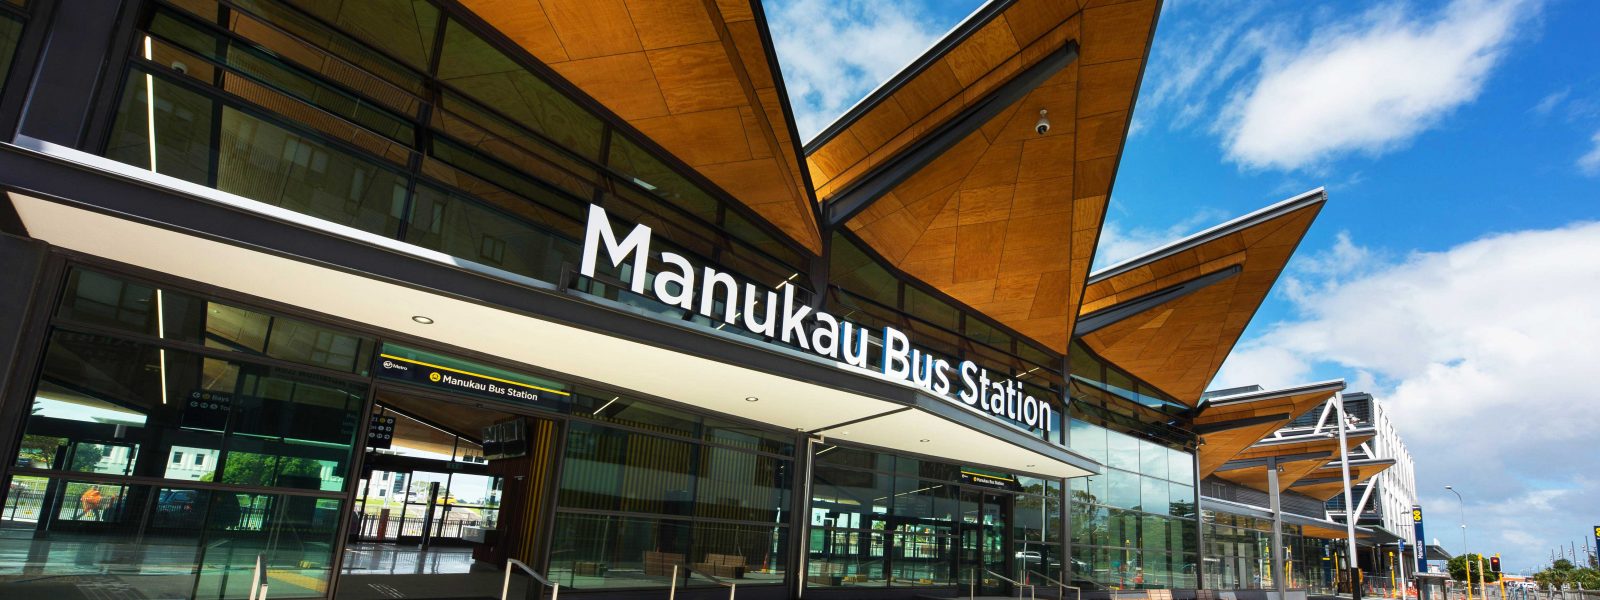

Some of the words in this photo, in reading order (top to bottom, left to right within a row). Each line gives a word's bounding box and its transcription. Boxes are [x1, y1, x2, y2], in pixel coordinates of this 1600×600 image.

[580, 203, 868, 369] Manukau
[883, 326, 950, 397] Bus
[958, 361, 1052, 432] Station
[393, 363, 408, 371] Metro
[442, 374, 486, 391] Manukau
[488, 384, 505, 395] Bus
[507, 388, 538, 401] Station
